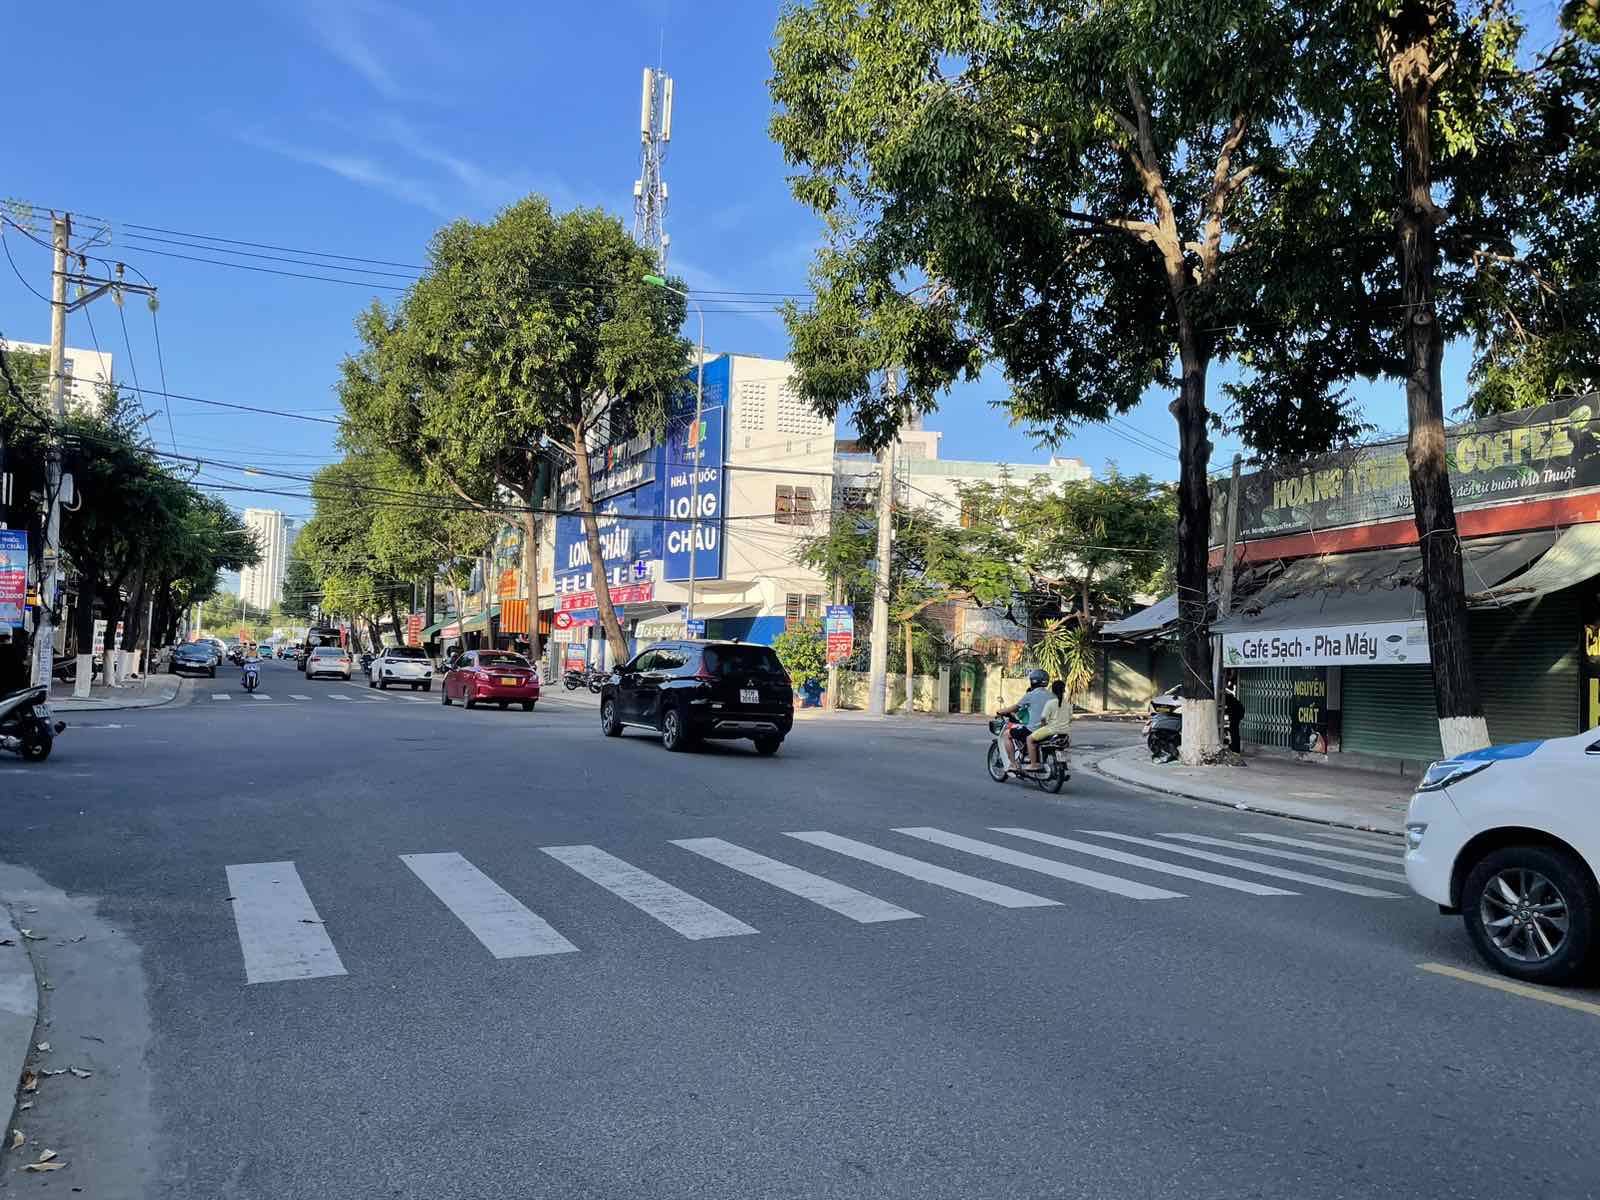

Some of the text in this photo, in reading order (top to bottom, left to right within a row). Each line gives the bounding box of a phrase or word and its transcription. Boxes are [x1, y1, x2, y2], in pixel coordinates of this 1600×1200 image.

[1456, 418, 1575, 474] COFFEE
[670, 471, 688, 488] NHÀ
[1542, 466, 1577, 484] Thuột
[669, 492, 717, 520] LONG
[667, 523, 716, 553] CHÂU
[568, 539, 592, 568] LON
[1242, 639, 1269, 658] Cafe
[1271, 636, 1302, 663] Sạch
[1314, 634, 1342, 657] Pha
[1345, 631, 1378, 660] Máy
[1294, 677, 1325, 697] NGUYÊN
[1298, 701, 1320, 724] CHẤT
